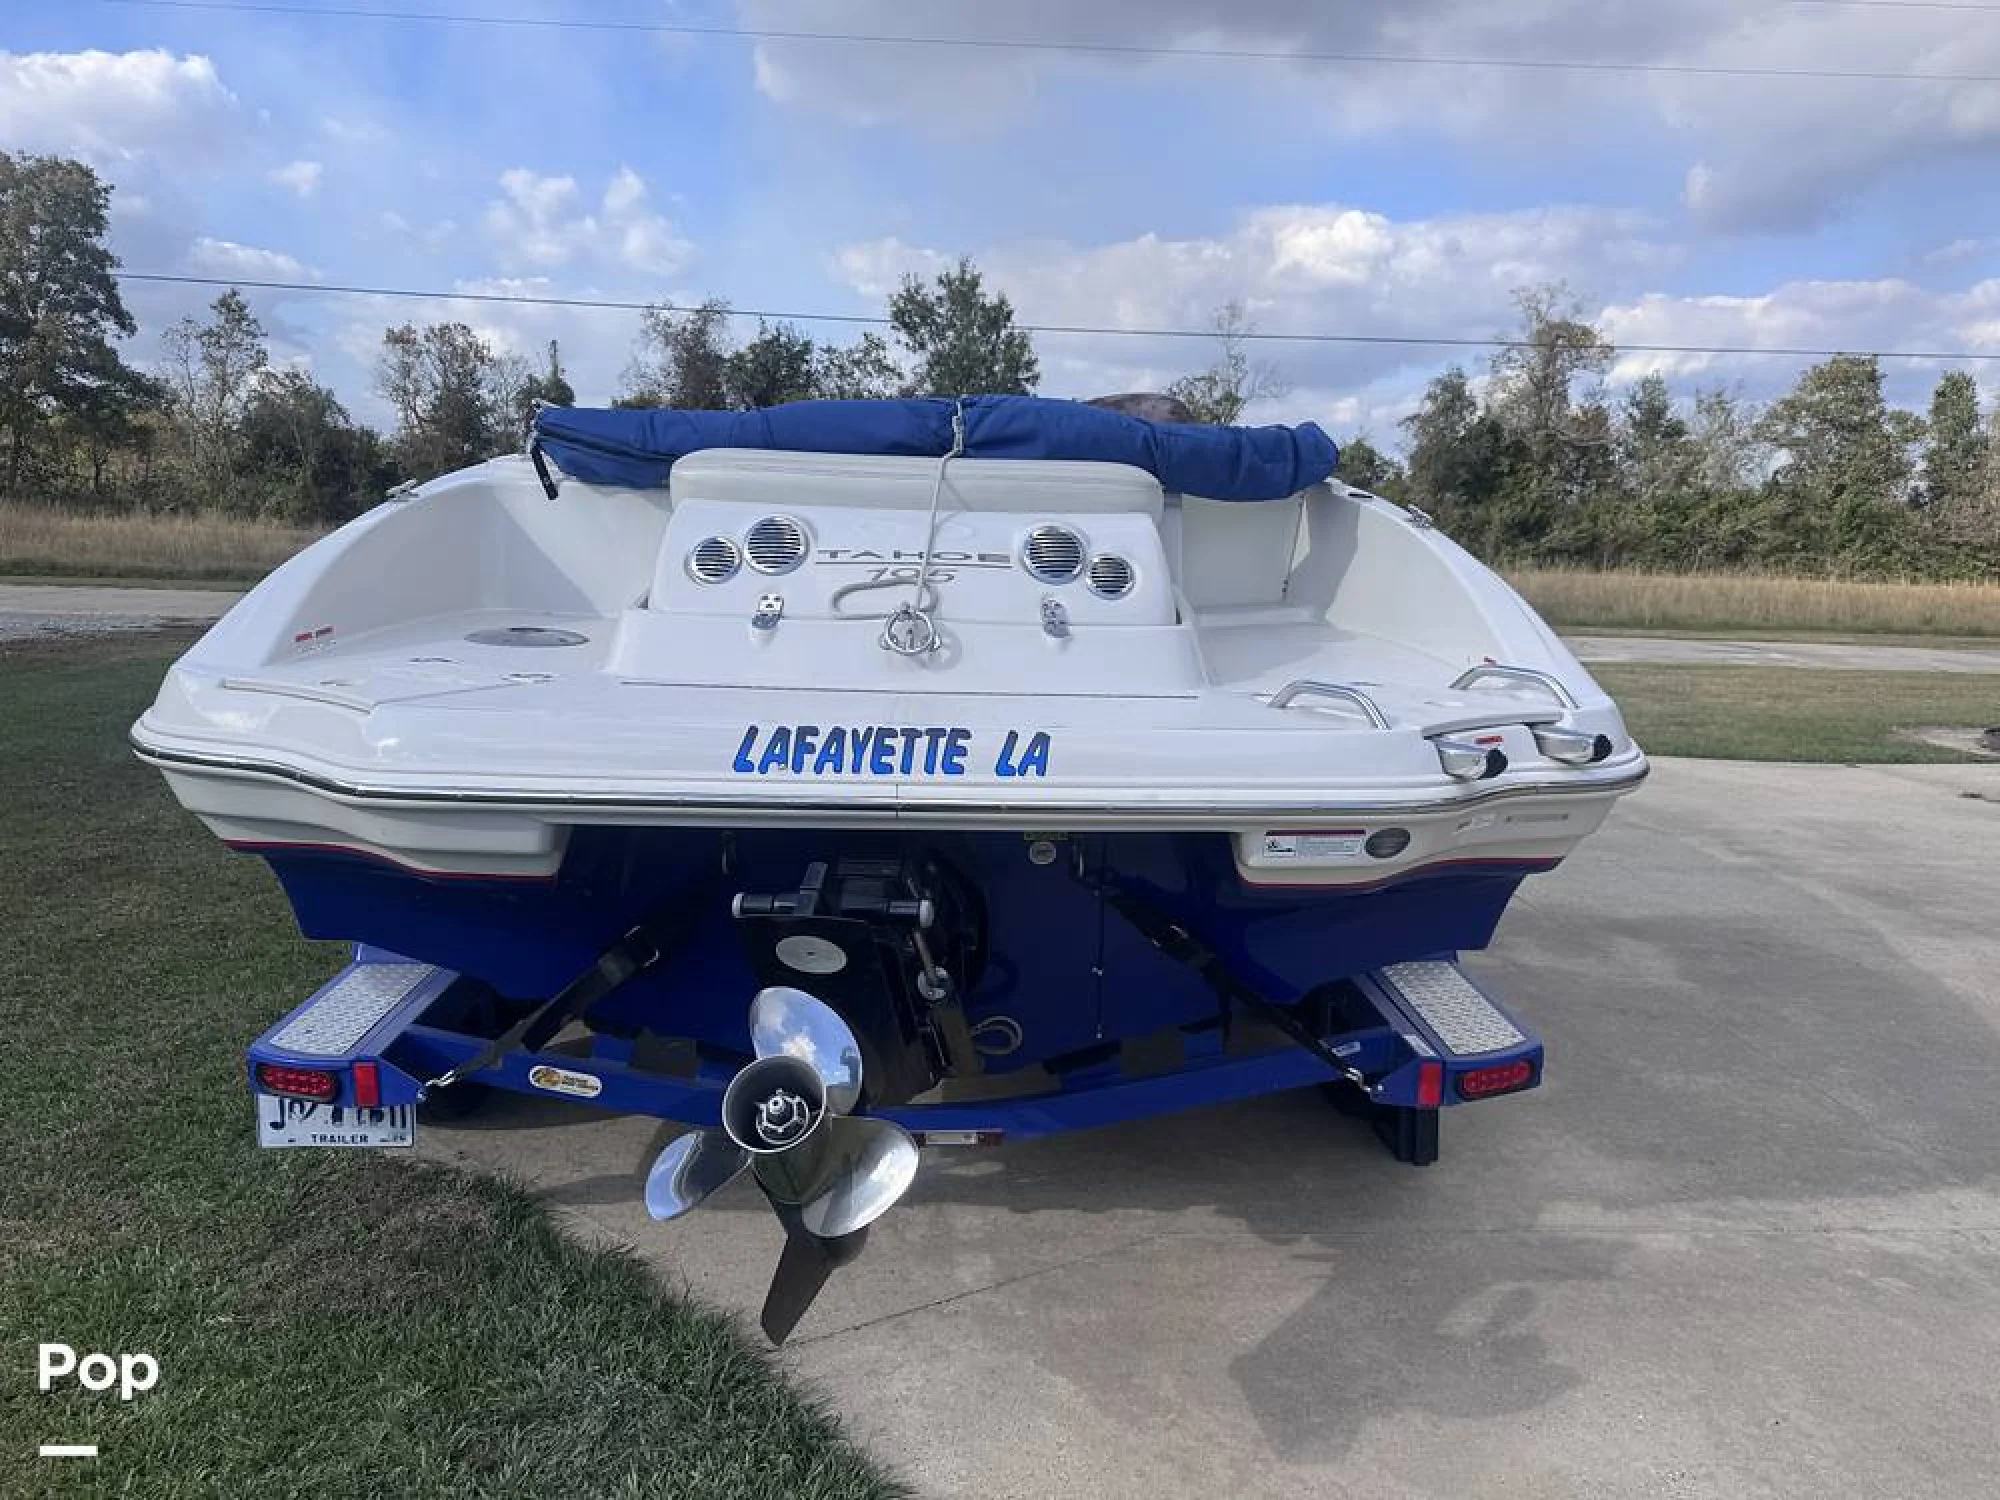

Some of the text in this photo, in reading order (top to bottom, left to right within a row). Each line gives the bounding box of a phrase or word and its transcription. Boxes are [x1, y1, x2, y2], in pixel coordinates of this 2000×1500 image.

[817, 549, 1011, 562] TAHOE
[732, 725, 1051, 777] LAFAYETTE LA
[311, 1133, 369, 1144] TRAILER
